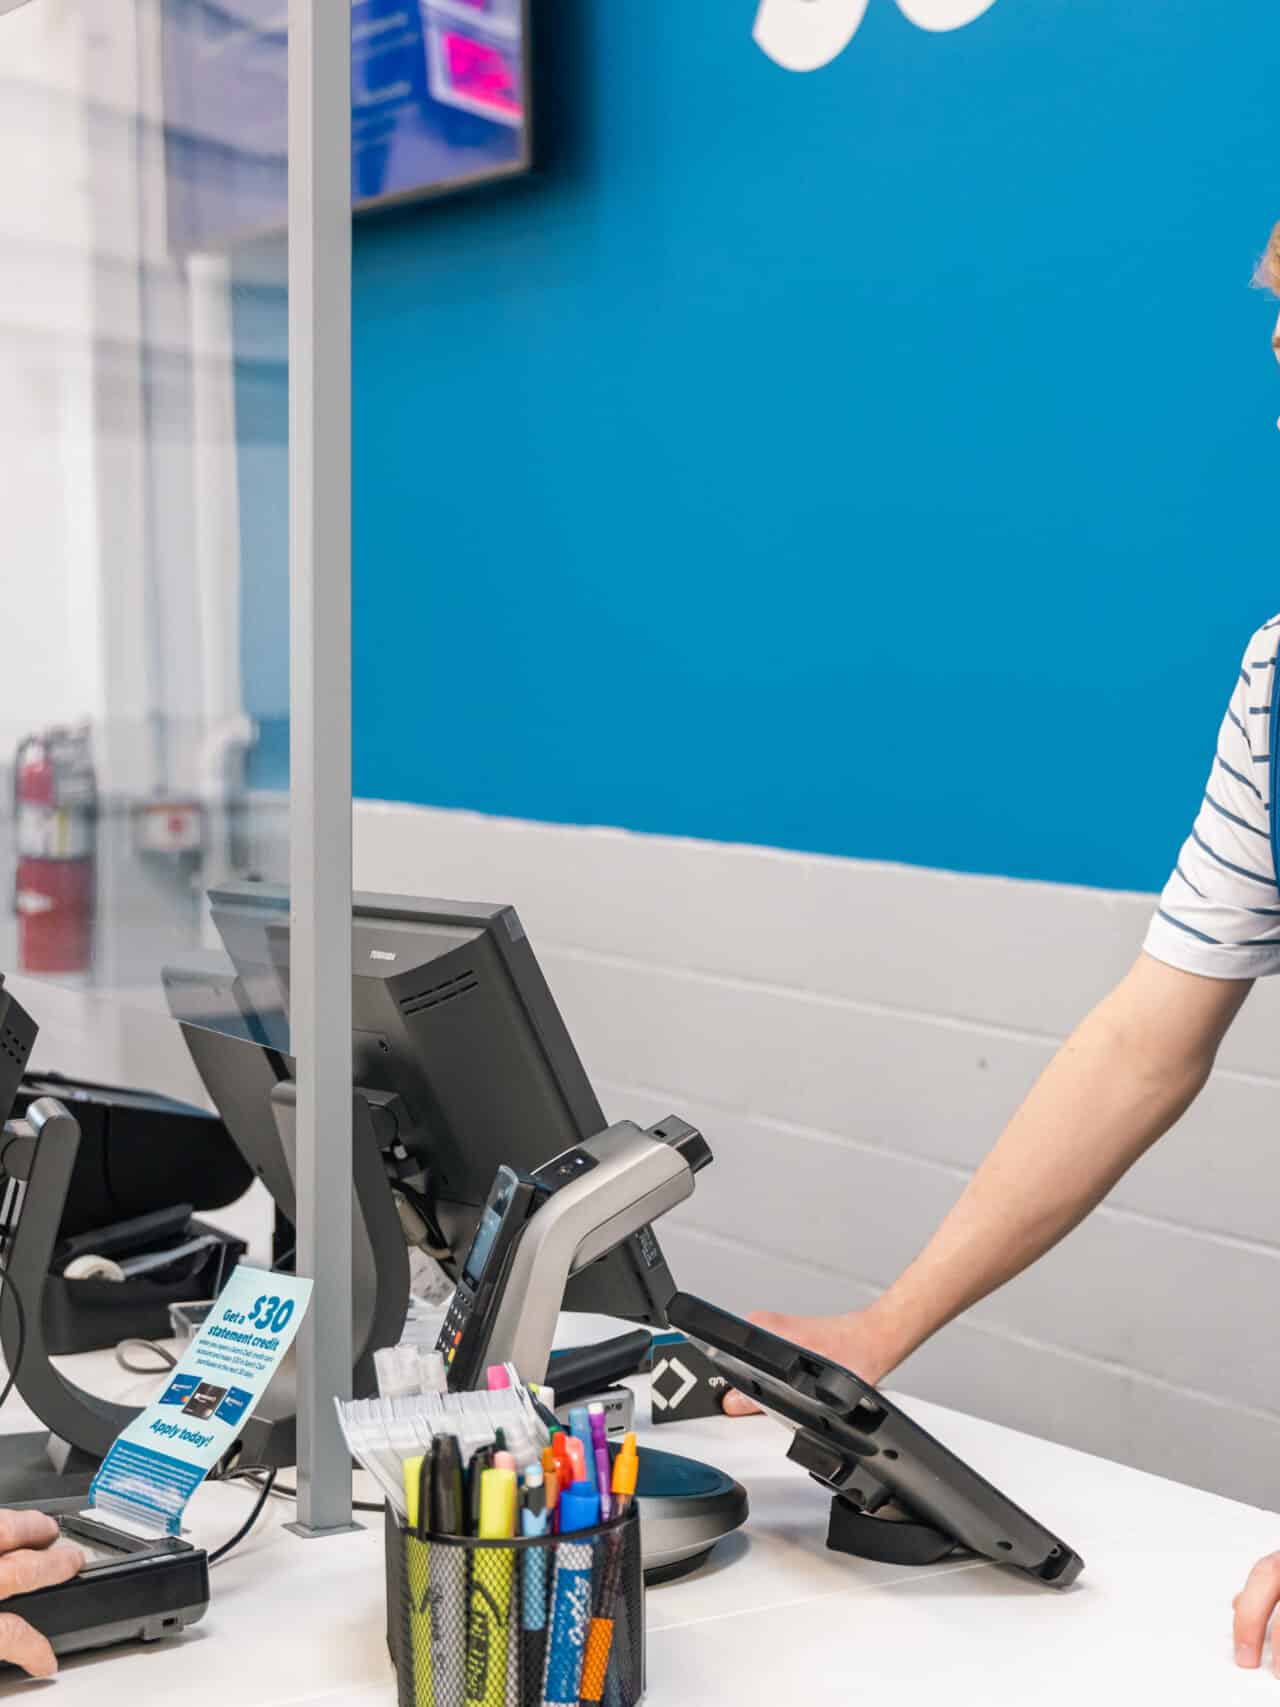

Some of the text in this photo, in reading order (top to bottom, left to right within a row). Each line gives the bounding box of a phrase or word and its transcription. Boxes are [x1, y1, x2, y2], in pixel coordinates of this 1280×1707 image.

[222, 1294, 296, 1334] Get a $30
[207, 1325, 253, 1346] statement
[252, 1333, 281, 1351] credit
[149, 1418, 216, 1449] Apply today!
